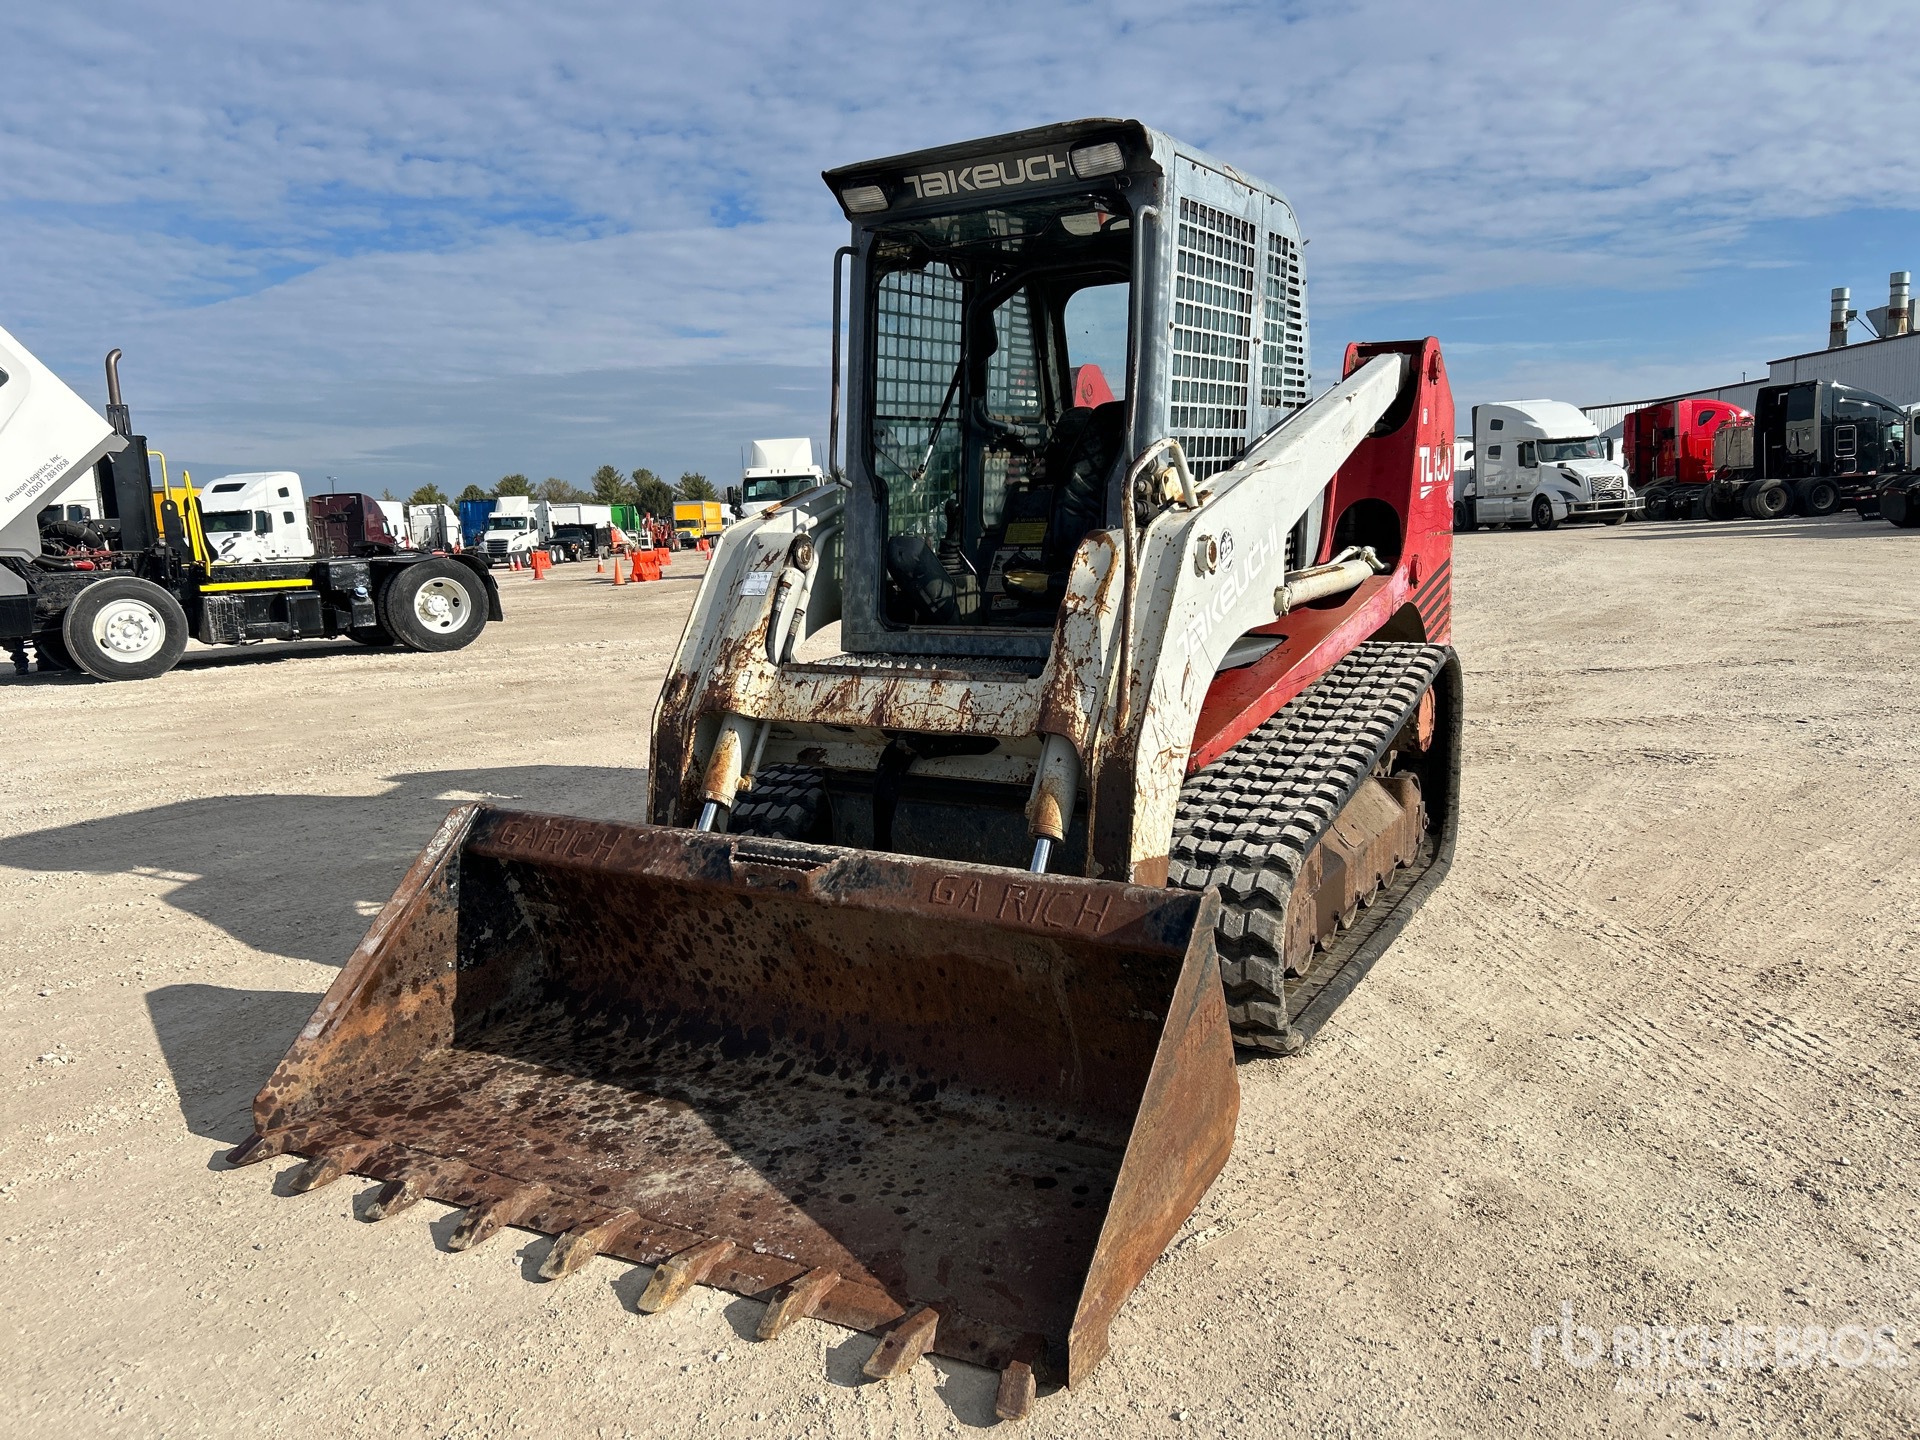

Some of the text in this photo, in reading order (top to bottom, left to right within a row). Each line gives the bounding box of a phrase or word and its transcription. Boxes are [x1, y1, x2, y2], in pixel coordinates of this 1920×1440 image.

[5, 454, 63, 503] Amazon Logistics, Inc.
[25, 458, 70, 498] USDOT 2881058
[996, 883, 1113, 933] RICH
